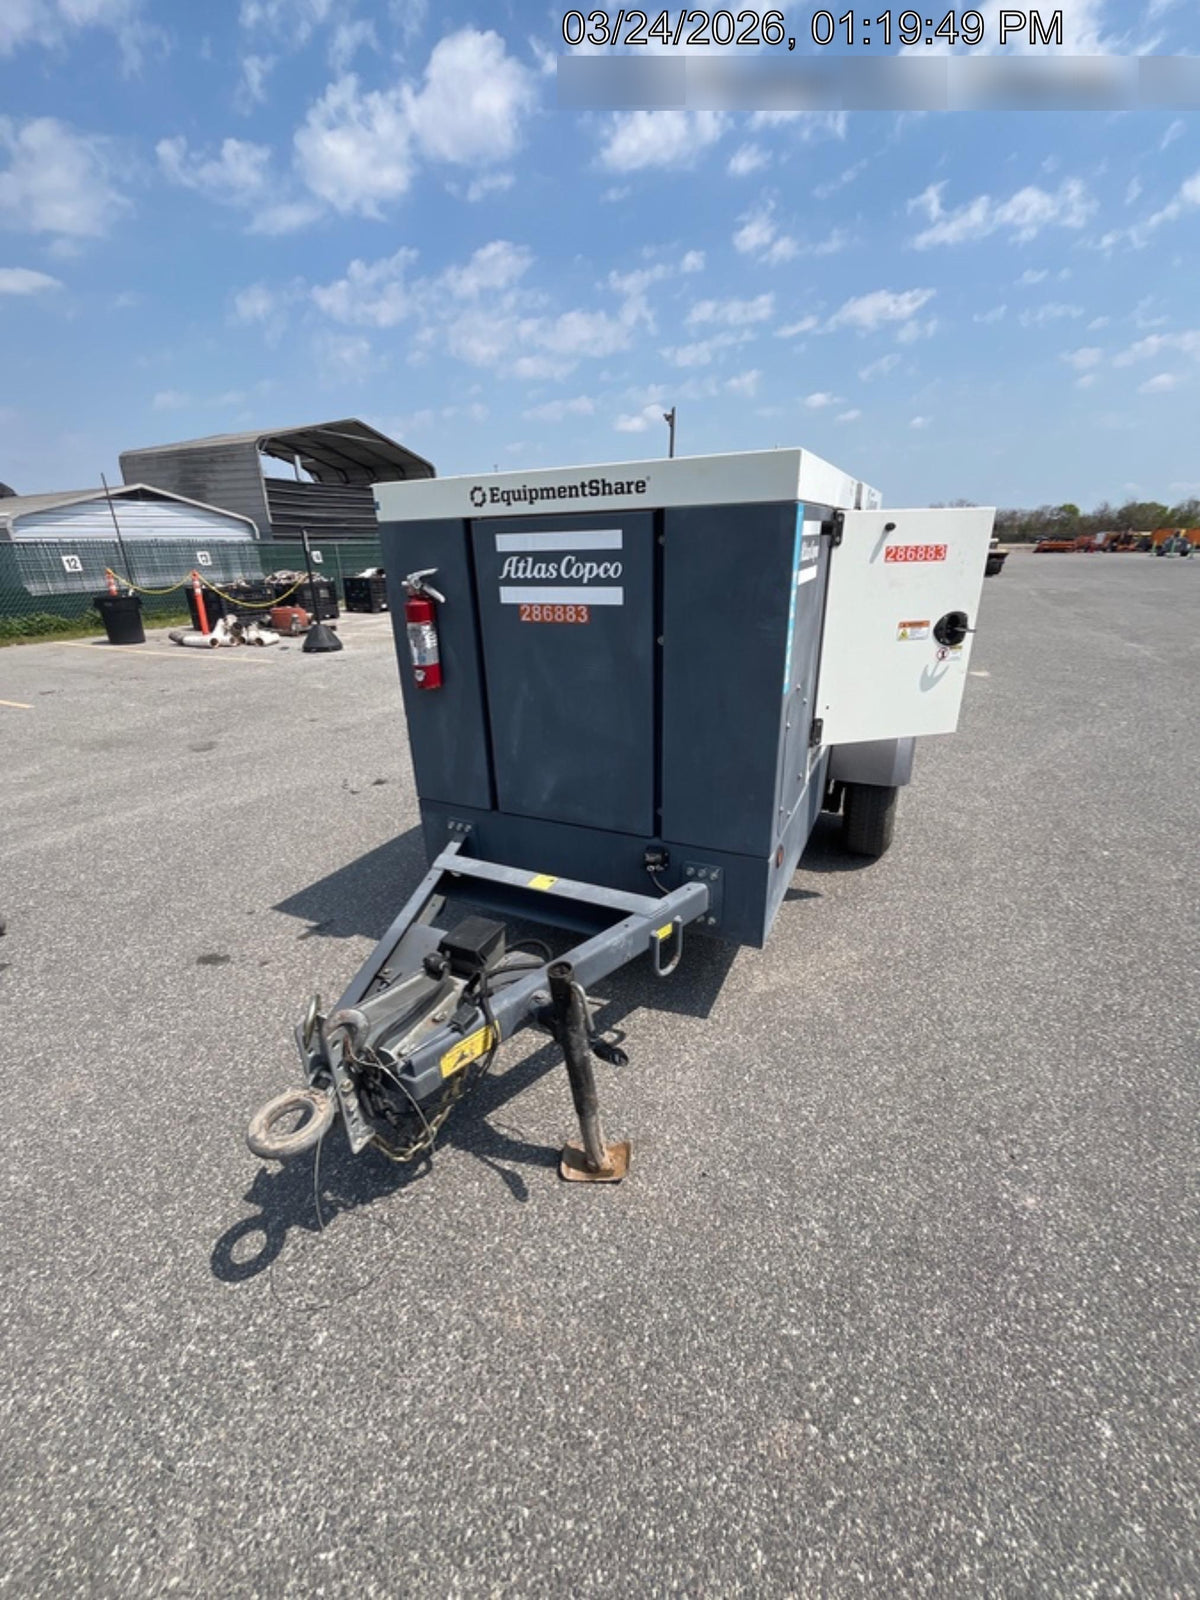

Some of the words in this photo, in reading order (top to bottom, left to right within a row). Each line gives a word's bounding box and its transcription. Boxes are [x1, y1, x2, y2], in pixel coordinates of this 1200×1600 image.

[489, 478, 646, 506] EquipmentShare
[886, 545, 946, 561] 286883
[65, 558, 79, 570] 12
[499, 556, 558, 579] Atlas
[559, 555, 623, 584] Copco
[520, 605, 589, 623] 286883
